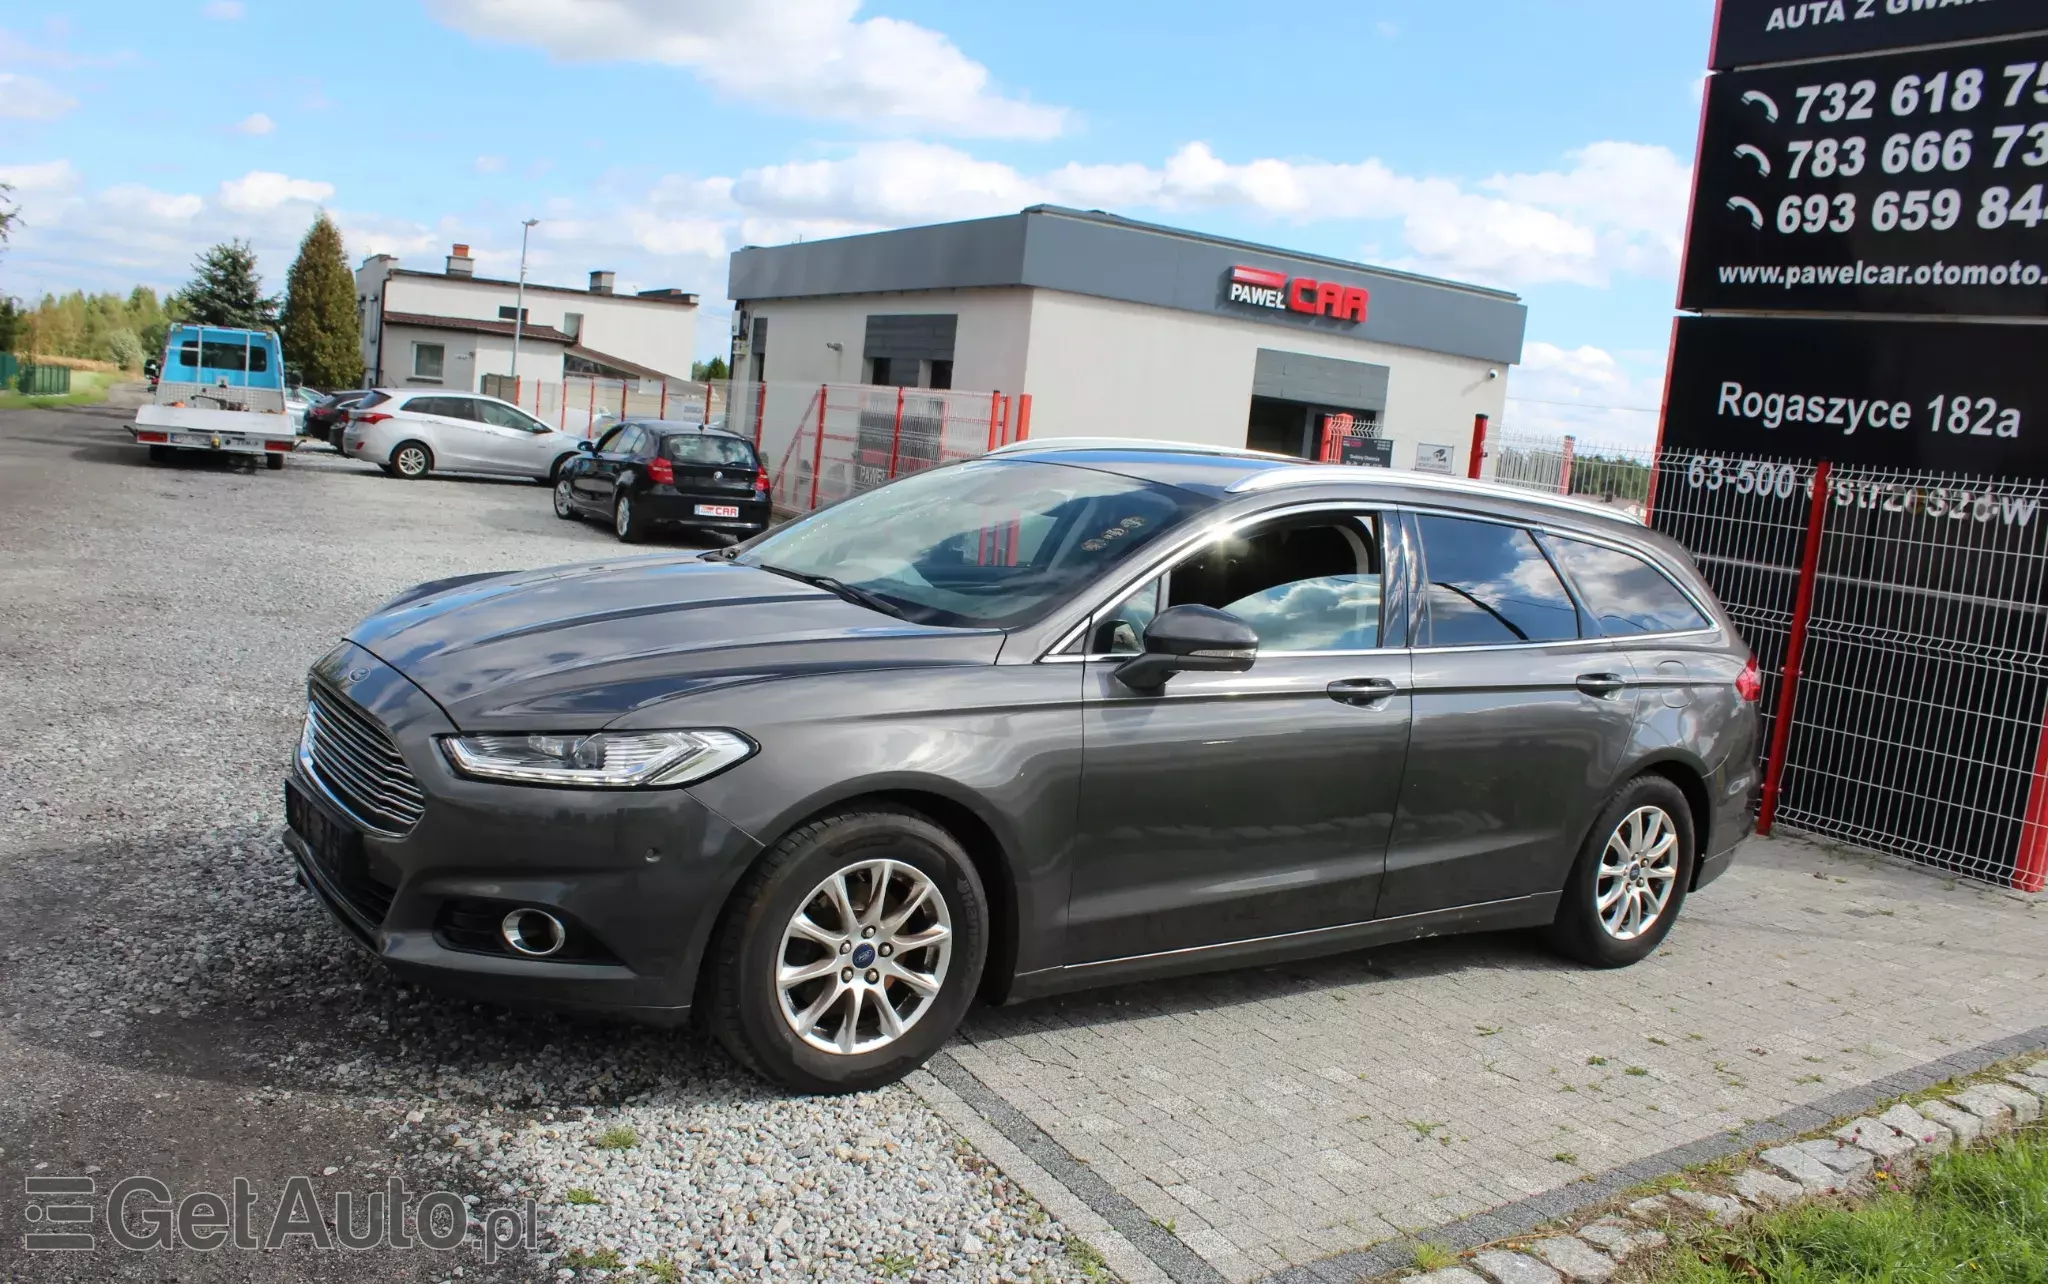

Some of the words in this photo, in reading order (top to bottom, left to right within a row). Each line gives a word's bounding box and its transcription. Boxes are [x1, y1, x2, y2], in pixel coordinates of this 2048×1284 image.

[1765, 1, 1846, 32] AUTA
[1853, 0, 1875, 20] Z
[1795, 79, 1877, 124] 732
[1890, 68, 1984, 117] 618
[1787, 137, 1867, 179] 783
[1881, 128, 1974, 174] 666
[1992, 121, 2048, 169] 73
[1777, 193, 1857, 234] 693
[1871, 188, 1961, 232] 659
[1976, 184, 2048, 230] 84
[1230, 283, 1286, 310] PAWEŁ
[1290, 277, 1370, 323] CAR
[1718, 381, 1911, 435] Rogaszyce
[1927, 394, 2022, 438] 182a
[1688, 455, 1796, 499] 63-500
[715, 506, 738, 517] CAR
